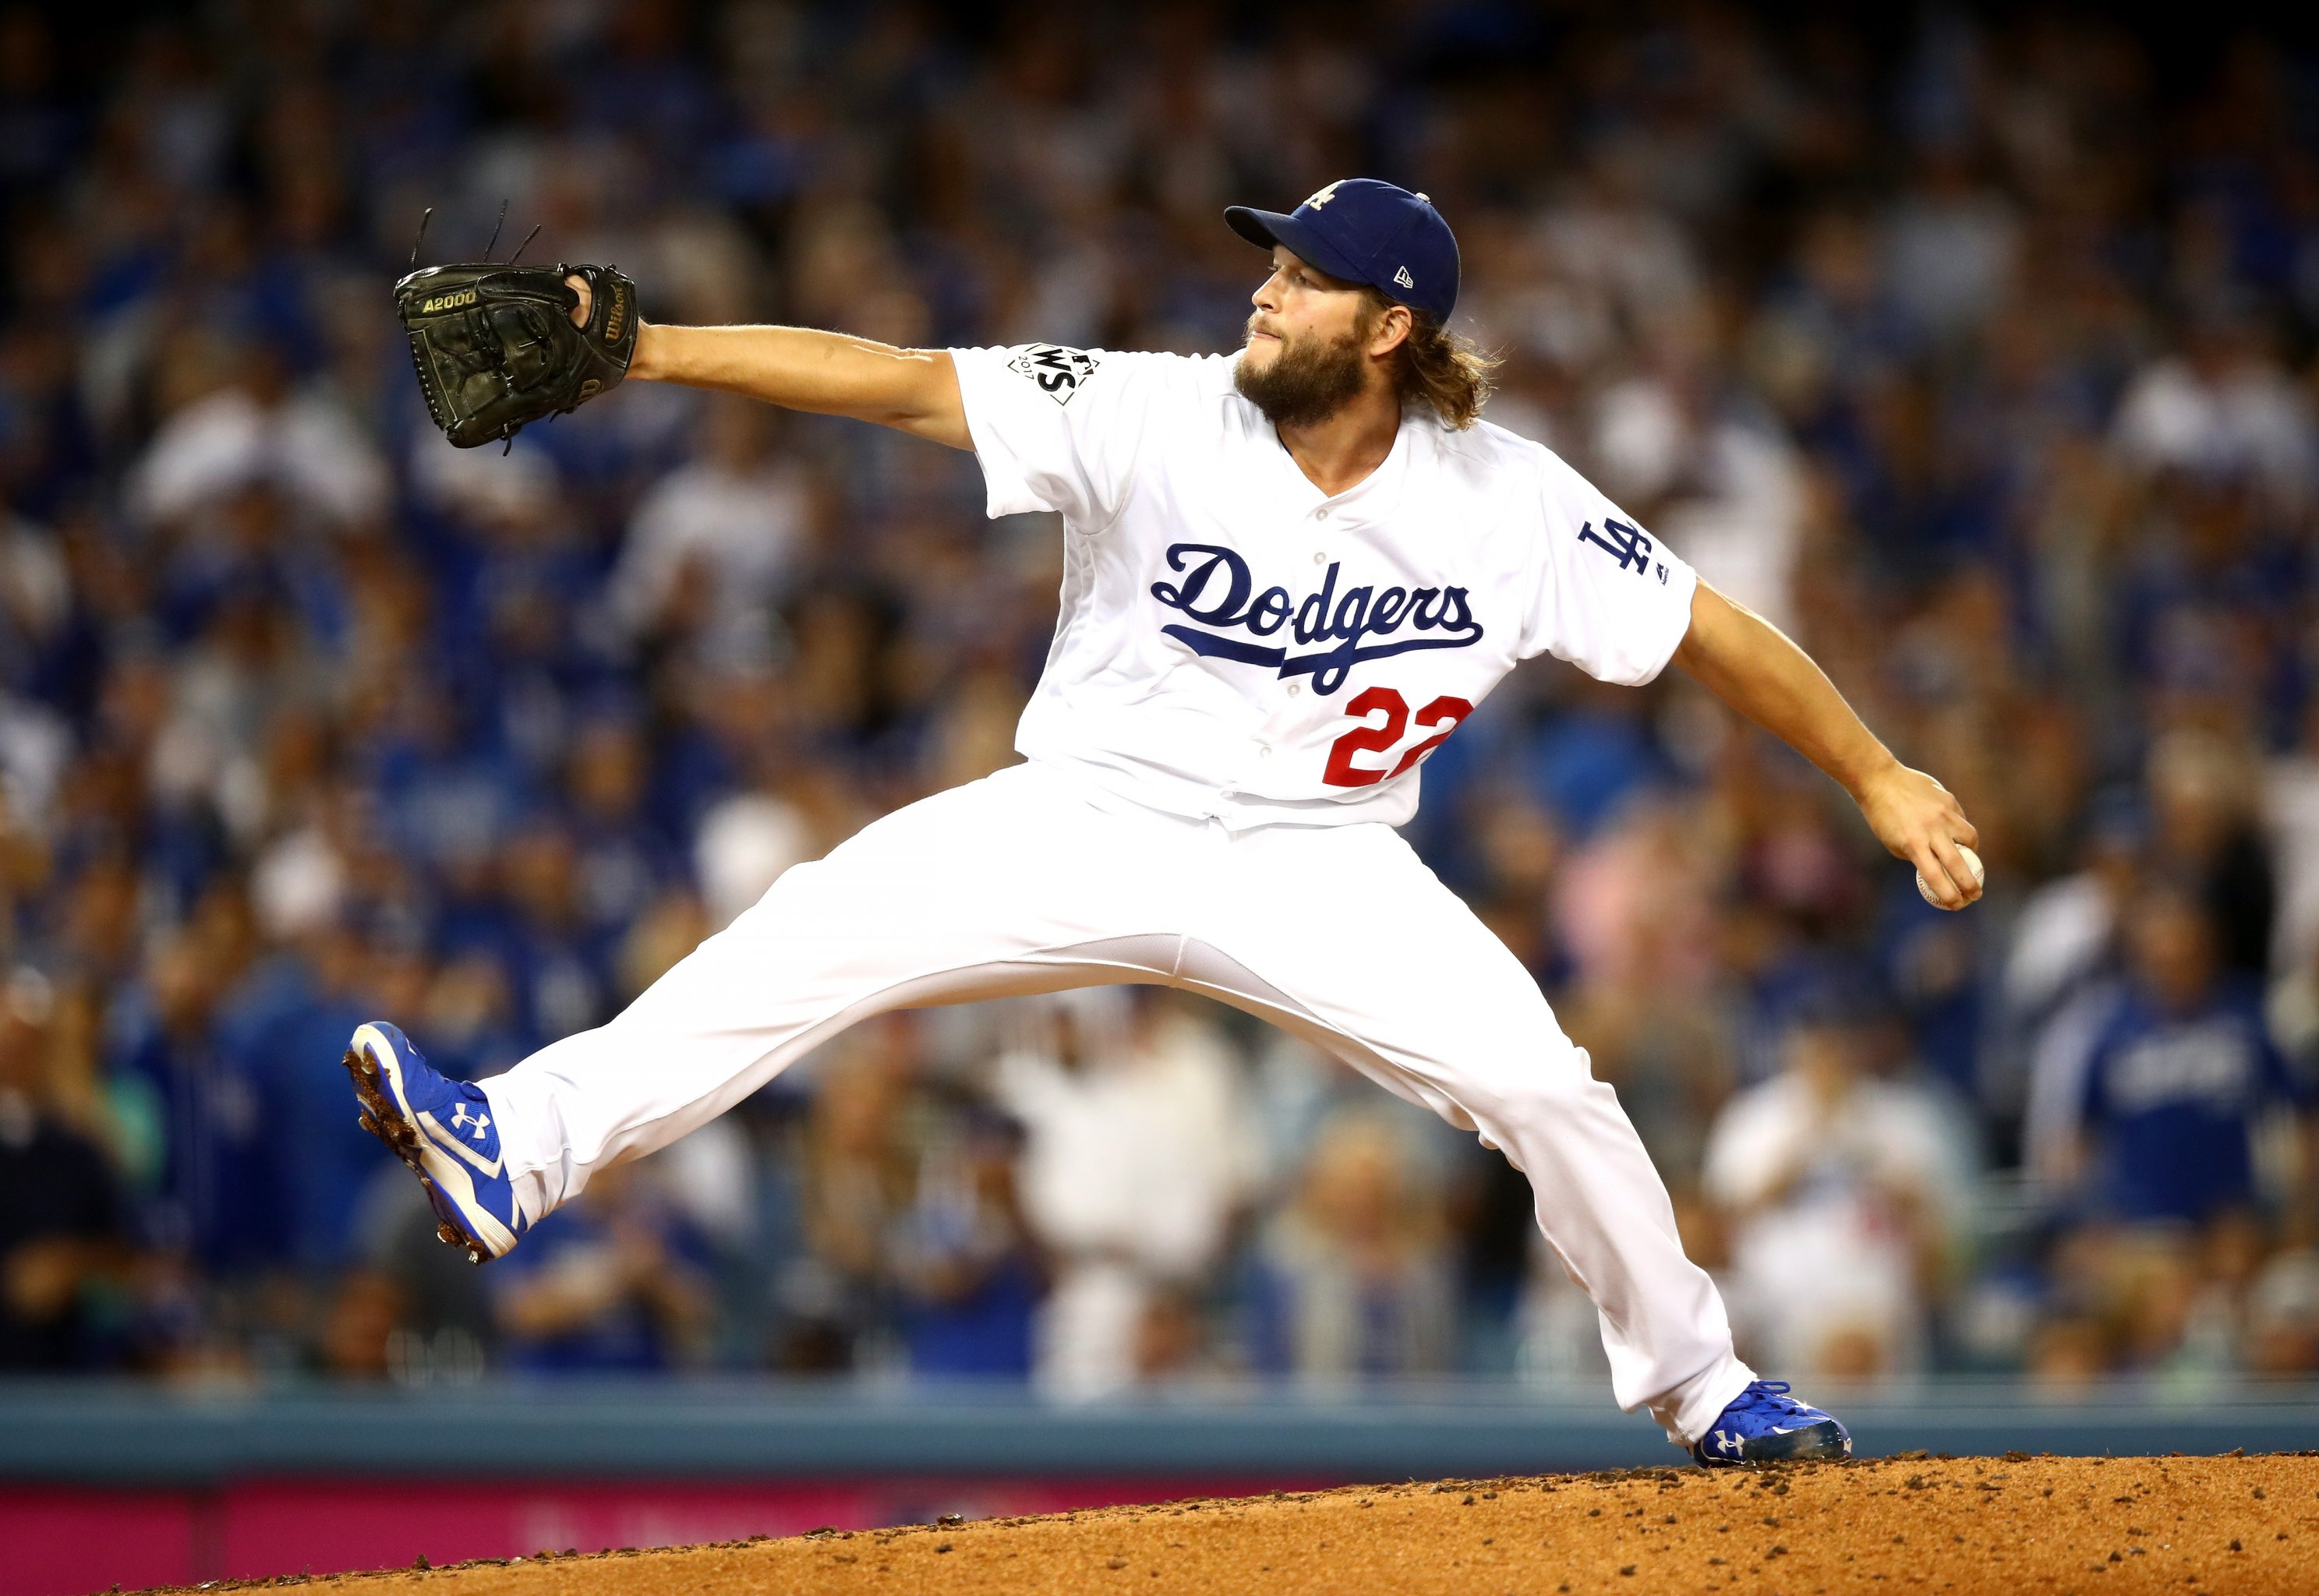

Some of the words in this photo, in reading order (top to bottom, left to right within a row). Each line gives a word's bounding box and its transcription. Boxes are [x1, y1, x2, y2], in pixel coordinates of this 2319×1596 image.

[422, 291, 476, 313] A2000
[606, 284, 624, 341] Wilson
[1018, 355, 1035, 380] 2017
[1032, 348, 1076, 392] WS
[1578, 517, 1653, 576] LA
[1151, 543, 1483, 696] Dodgers
[1322, 687, 1475, 787] 22
